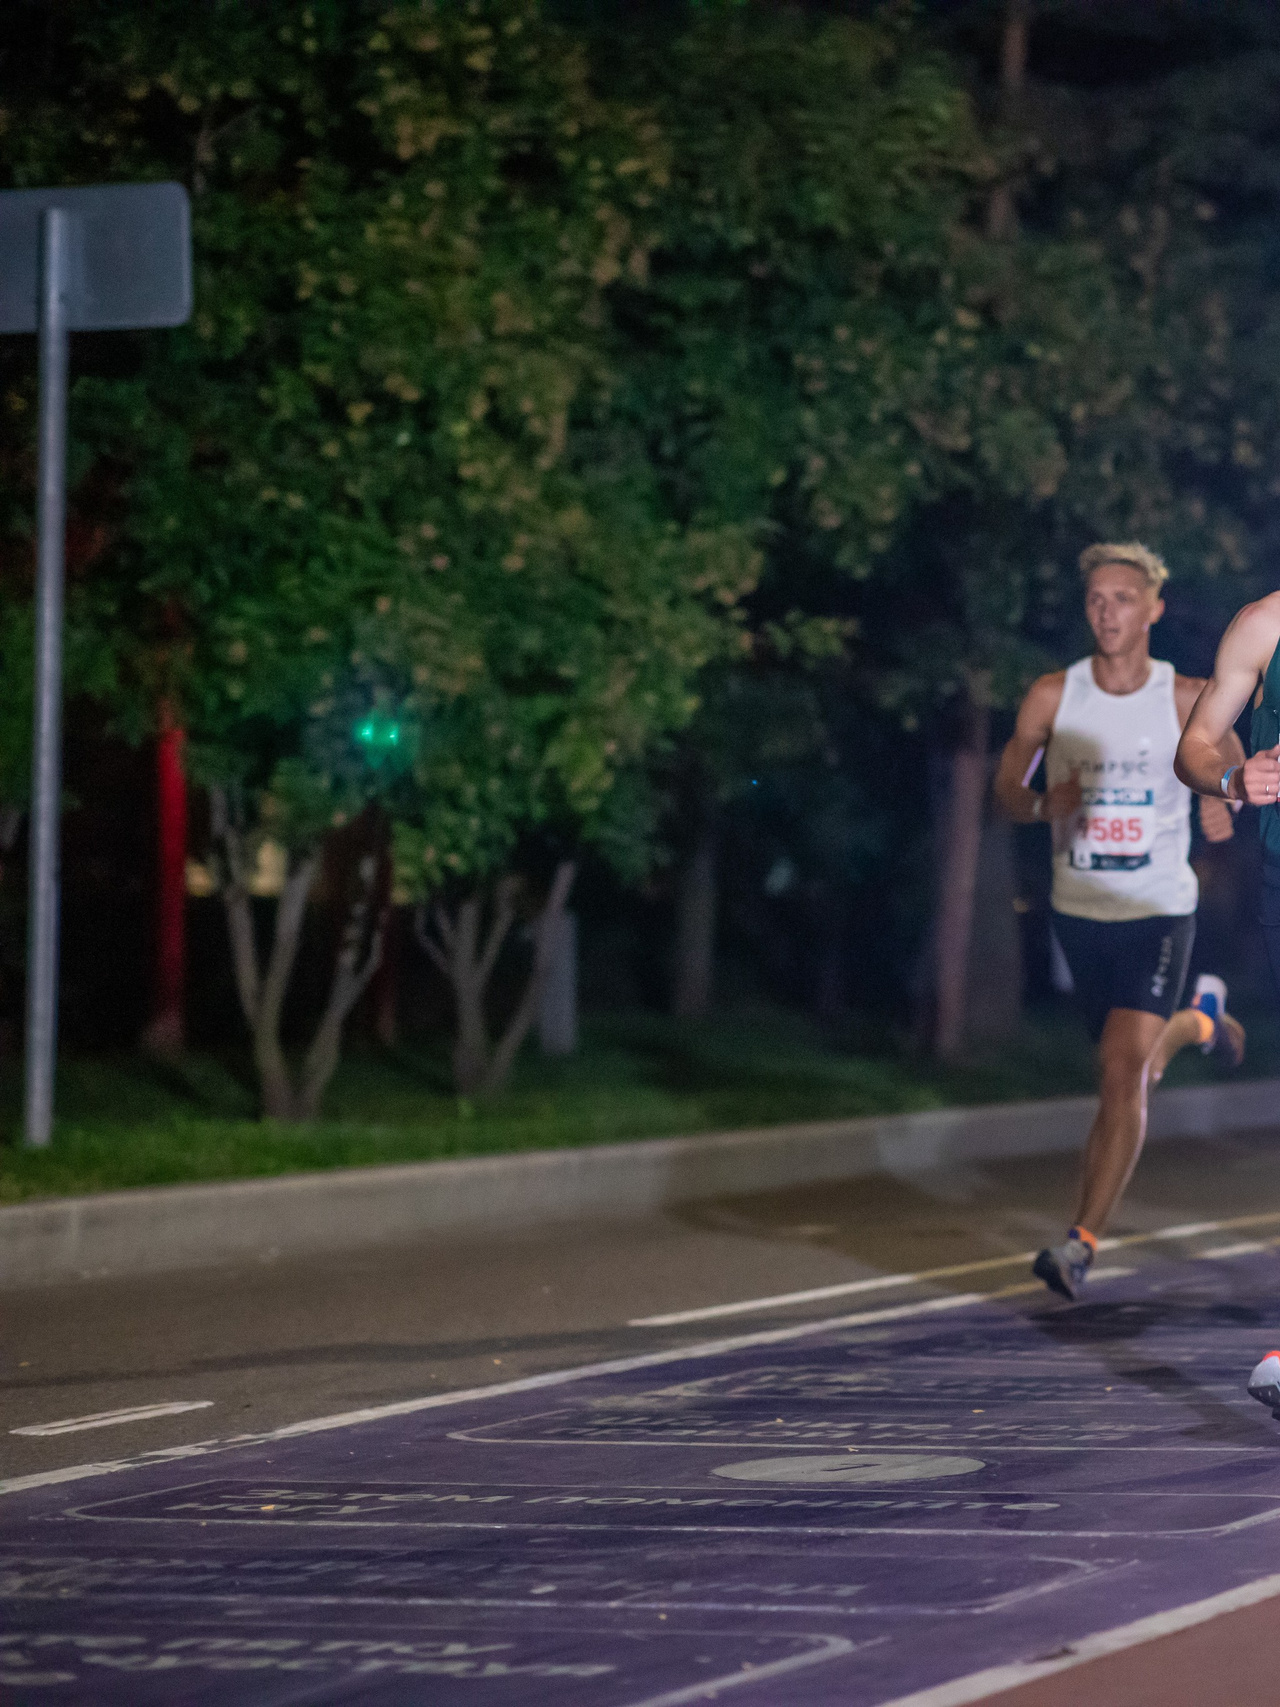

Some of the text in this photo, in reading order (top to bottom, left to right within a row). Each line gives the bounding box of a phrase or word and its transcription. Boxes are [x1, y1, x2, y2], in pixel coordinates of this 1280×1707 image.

[1087, 816, 1144, 843] 585
[165, 1503, 399, 1515] ногу
[220, 1489, 1062, 1512] Затем поменяйте
